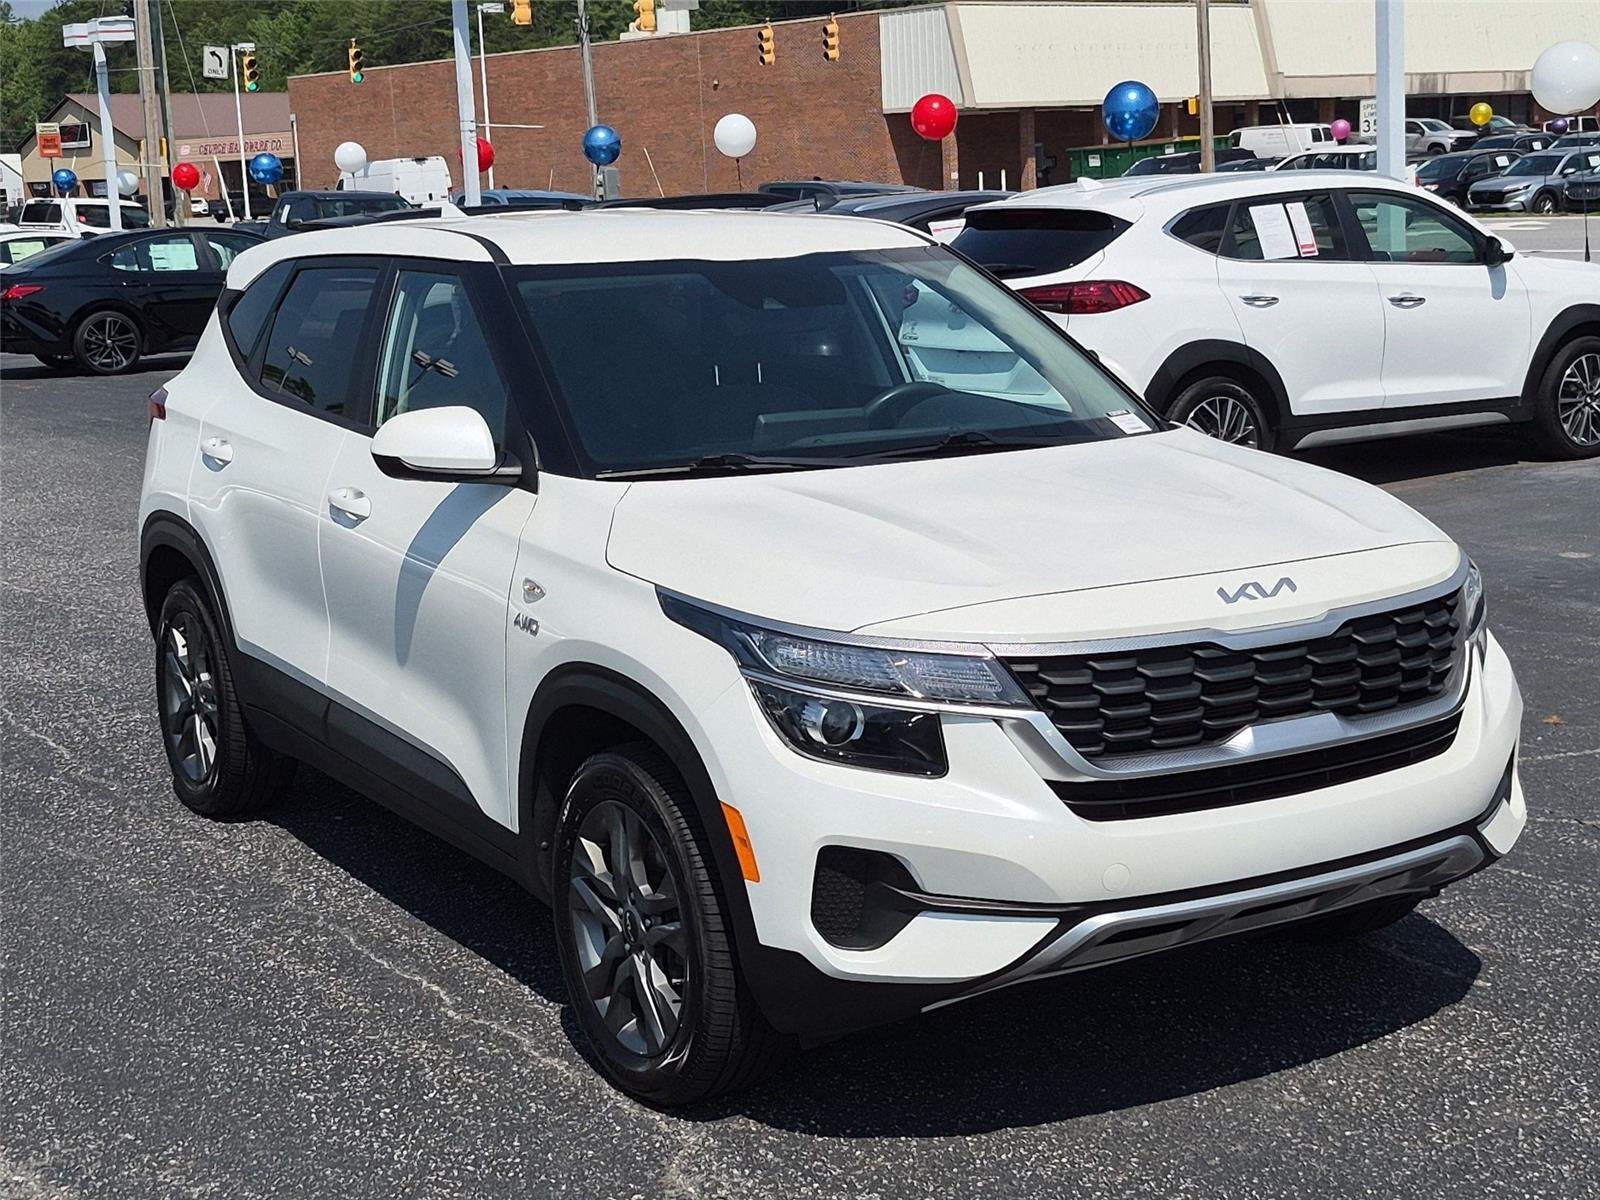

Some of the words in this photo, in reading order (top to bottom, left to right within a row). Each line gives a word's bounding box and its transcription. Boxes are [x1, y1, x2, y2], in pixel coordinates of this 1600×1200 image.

[207, 68, 224, 76] ONLY
[228, 140, 269, 153] HADWARE
[1216, 577, 1297, 604] KIA
[513, 612, 540, 637] AWD
